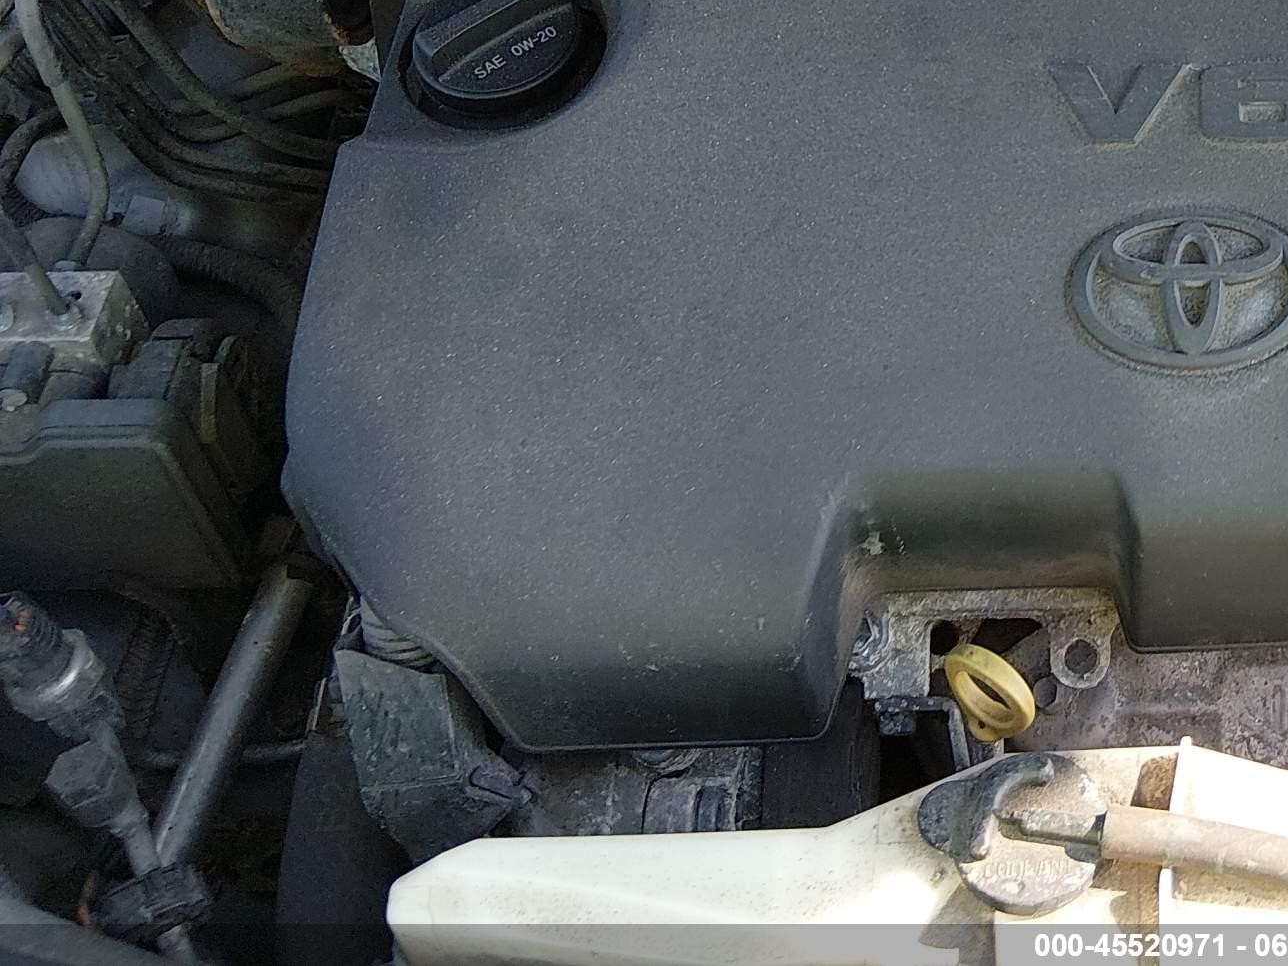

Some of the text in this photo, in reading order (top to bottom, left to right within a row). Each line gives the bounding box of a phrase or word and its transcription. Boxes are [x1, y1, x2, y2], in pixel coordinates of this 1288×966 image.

[474, 26, 557, 79] SAE 0W-20
[983, 858, 1071, 880] COOLANT
